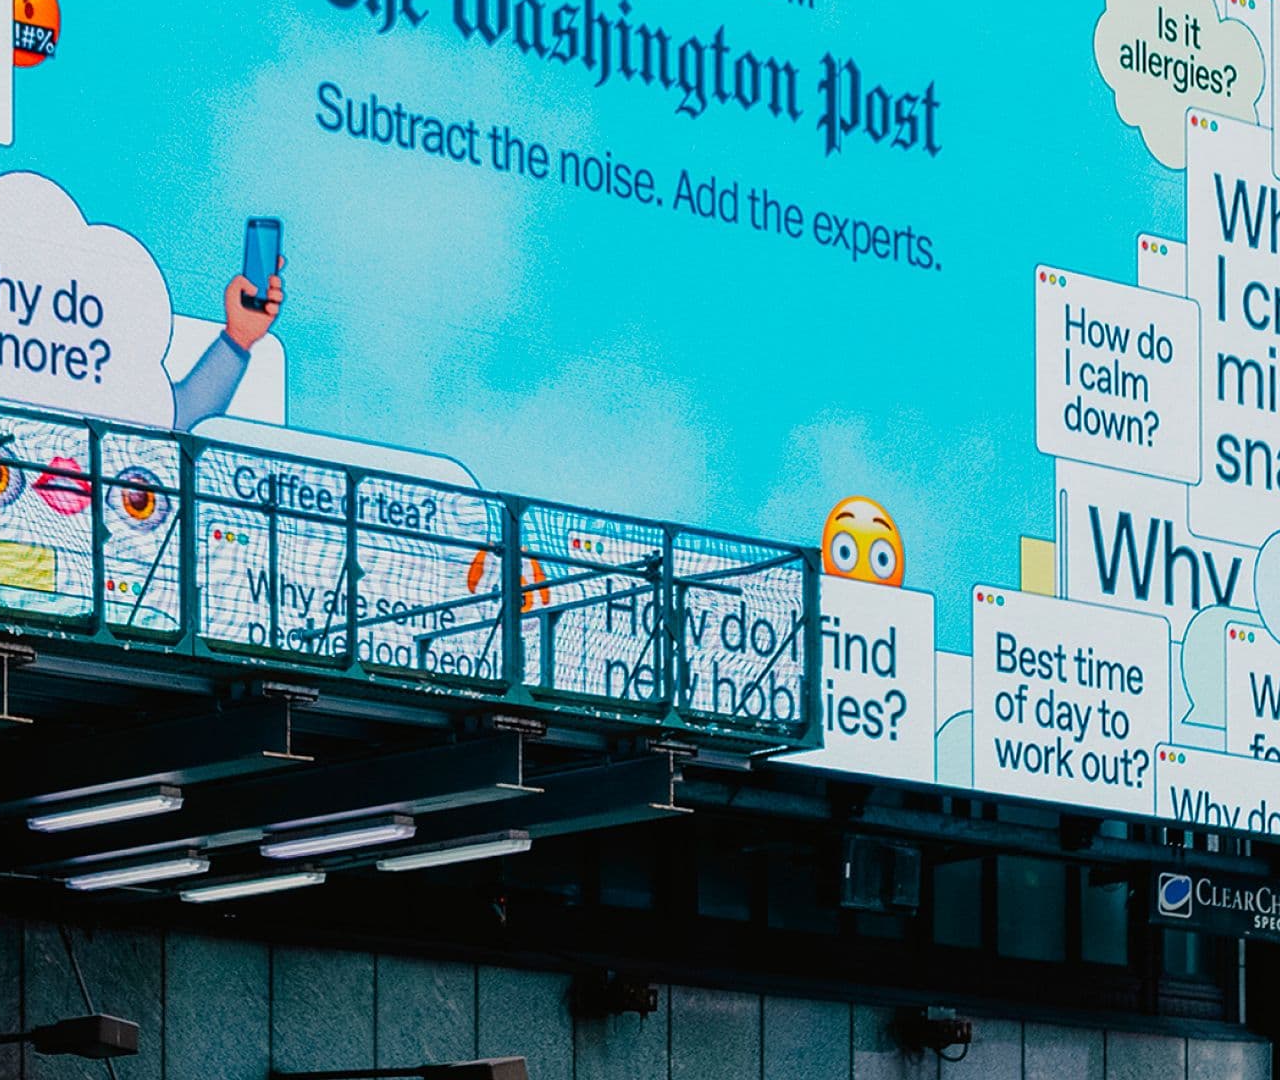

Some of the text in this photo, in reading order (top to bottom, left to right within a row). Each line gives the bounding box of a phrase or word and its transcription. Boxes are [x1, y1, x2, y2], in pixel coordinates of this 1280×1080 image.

[1157, 6, 1201, 49] Is it
[1119, 38, 1238, 98] allergies?
[816, 51, 942, 158] Post
[314, 81, 943, 273] Subtract the noise. Add the experts.
[52, 278, 104, 330] do
[1218, 254, 1227, 322] I
[1064, 304, 1174, 365] How do
[1064, 348, 1150, 404] I calm
[1063, 394, 1160, 448] down?
[378, 491, 438, 531] tea?
[1088, 503, 1243, 611] Why
[721, 601, 776, 658] do
[995, 631, 1145, 695] Best time
[994, 683, 1130, 744] of day to
[994, 735, 1150, 789] work out?
[1170, 785, 1241, 829] Why
